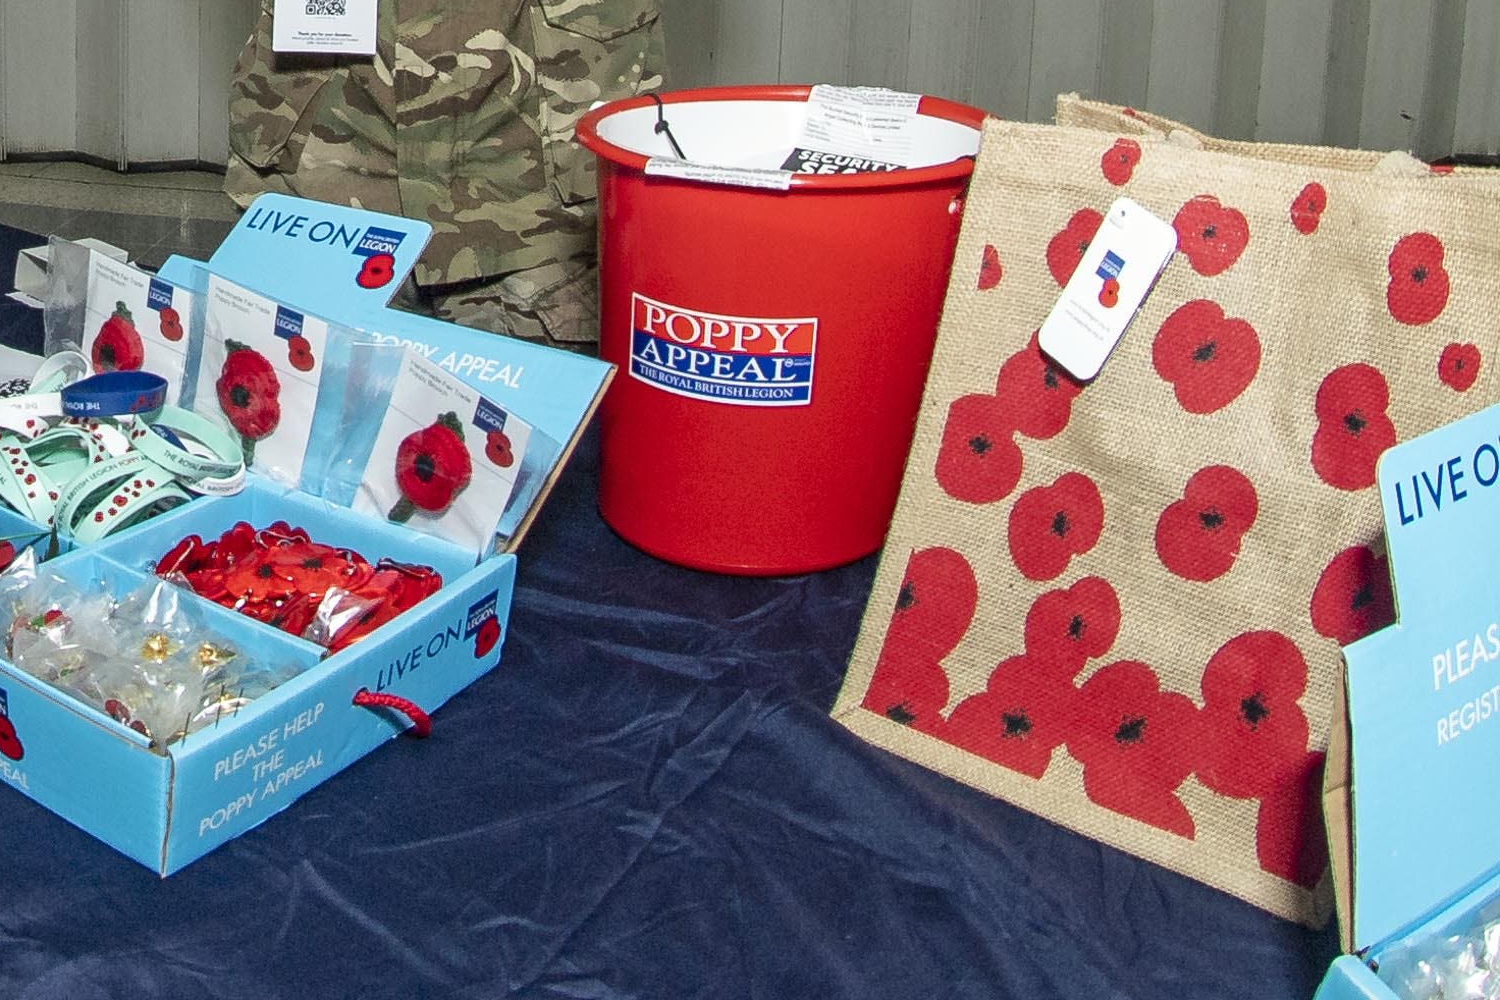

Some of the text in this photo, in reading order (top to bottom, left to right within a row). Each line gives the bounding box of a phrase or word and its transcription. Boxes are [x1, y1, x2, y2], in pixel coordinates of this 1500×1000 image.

[798, 150, 899, 173] SECURITY
[246, 208, 361, 249] LIVE ON
[359, 238, 397, 253] LEGION
[276, 317, 301, 334] LEGION
[643, 302, 798, 354] POPPY
[439, 352, 525, 389] APPEAL
[640, 338, 797, 382] APPEAL
[639, 364, 794, 399] THE ROYAL BRITISH LEGION
[476, 409, 503, 430] LEGION
[90, 464, 118, 481] LEGION
[164, 450, 177, 462] THE
[178, 457, 200, 471] ROYAL
[1395, 434, 1500, 526] LIVE O
[466, 604, 494, 631] LEGION
[376, 619, 463, 692] LIVE ON
[1432, 622, 1500, 692] PLEAS
[213, 702, 325, 782] PLEASE HELP
[252, 751, 285, 783] THE
[199, 749, 324, 838] POPPY APPEAL
